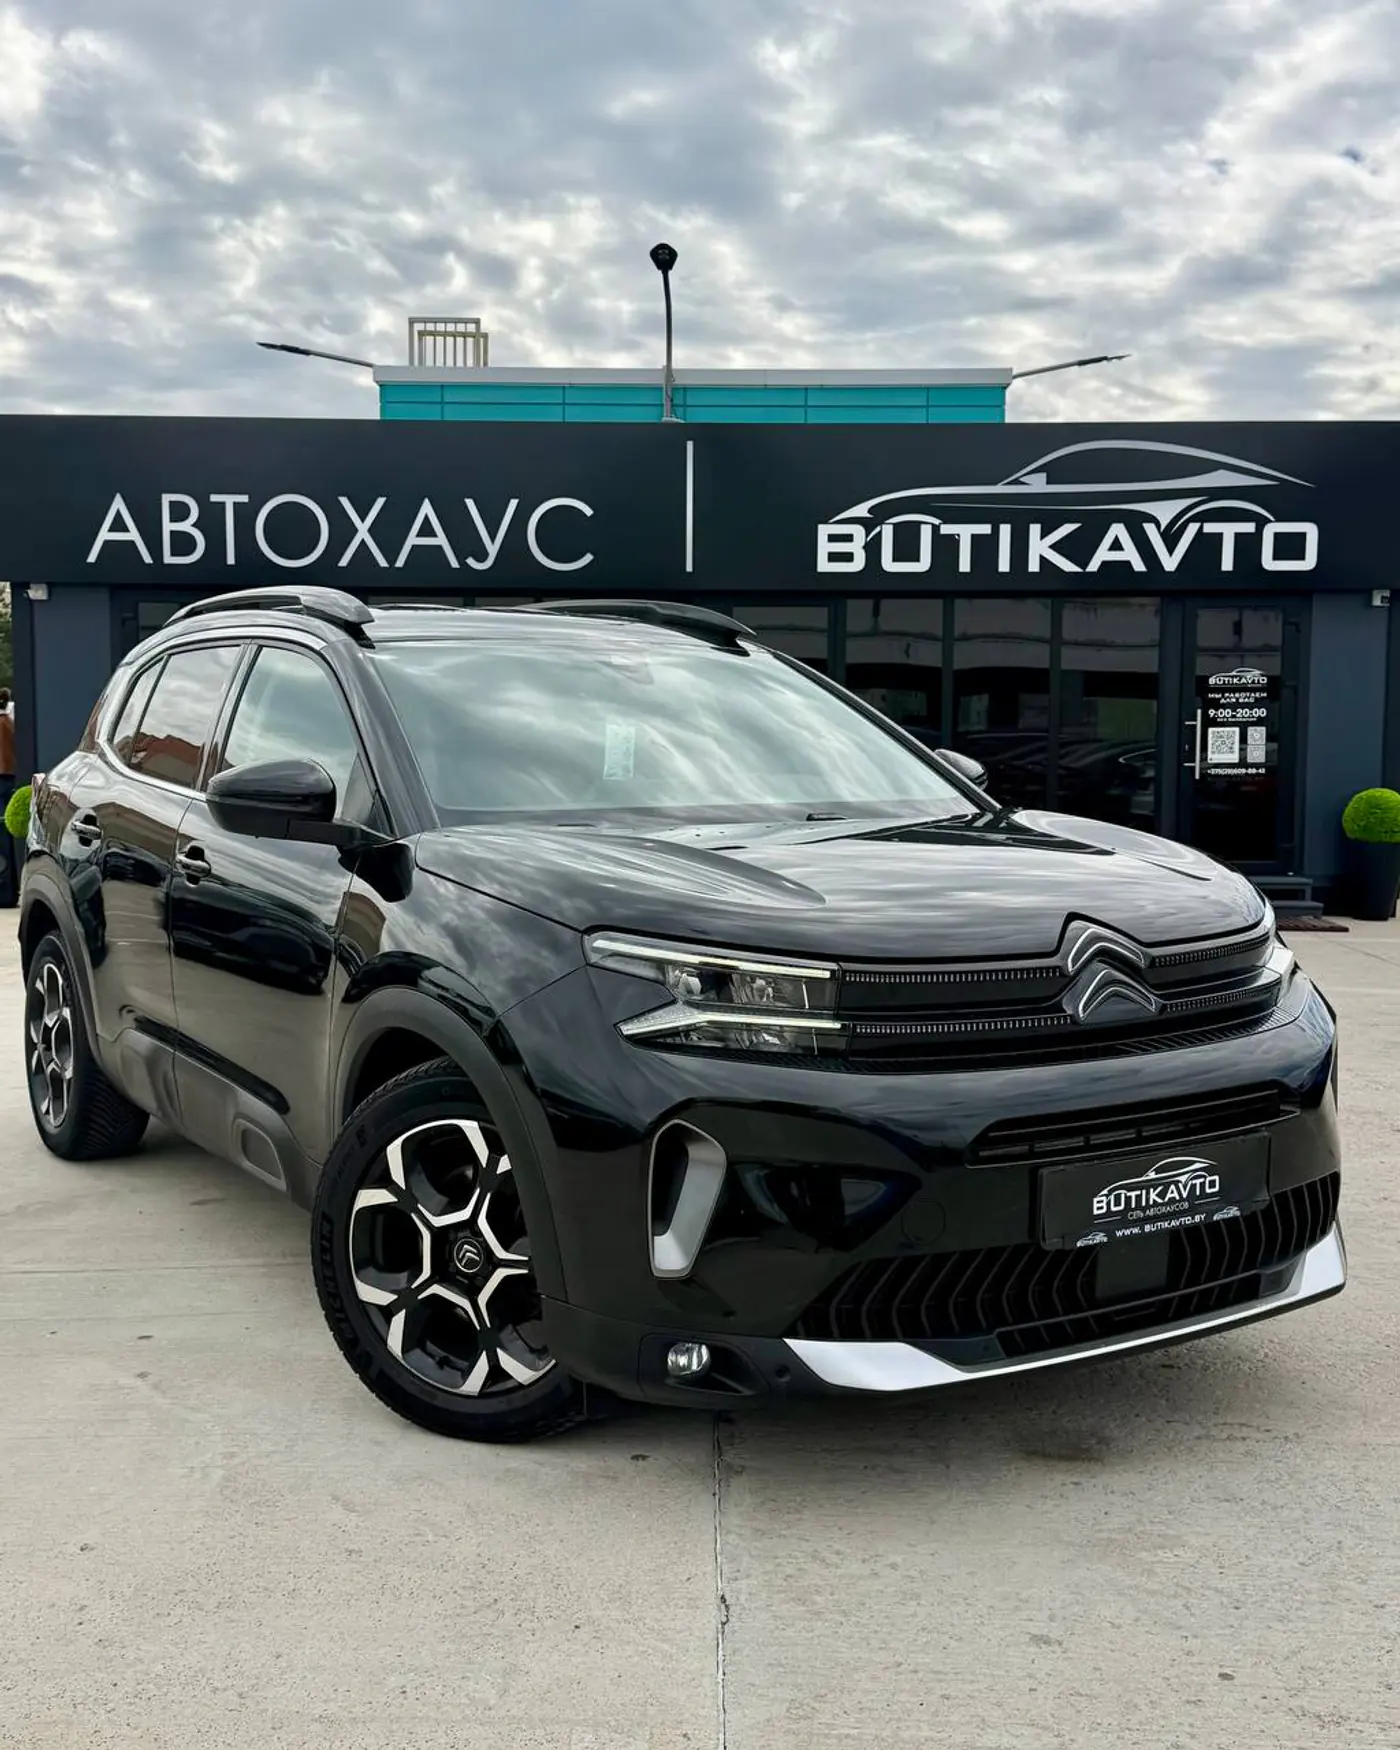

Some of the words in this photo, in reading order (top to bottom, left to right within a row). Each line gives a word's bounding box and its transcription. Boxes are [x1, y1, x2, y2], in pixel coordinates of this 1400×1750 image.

[86, 491, 595, 571] АВТОХАУС
[816, 521, 1319, 574] BUTIKAVTO
[1208, 708, 1267, 717] 9:00-20:00
[1093, 1175, 1220, 1216] BUTIKAVTO
